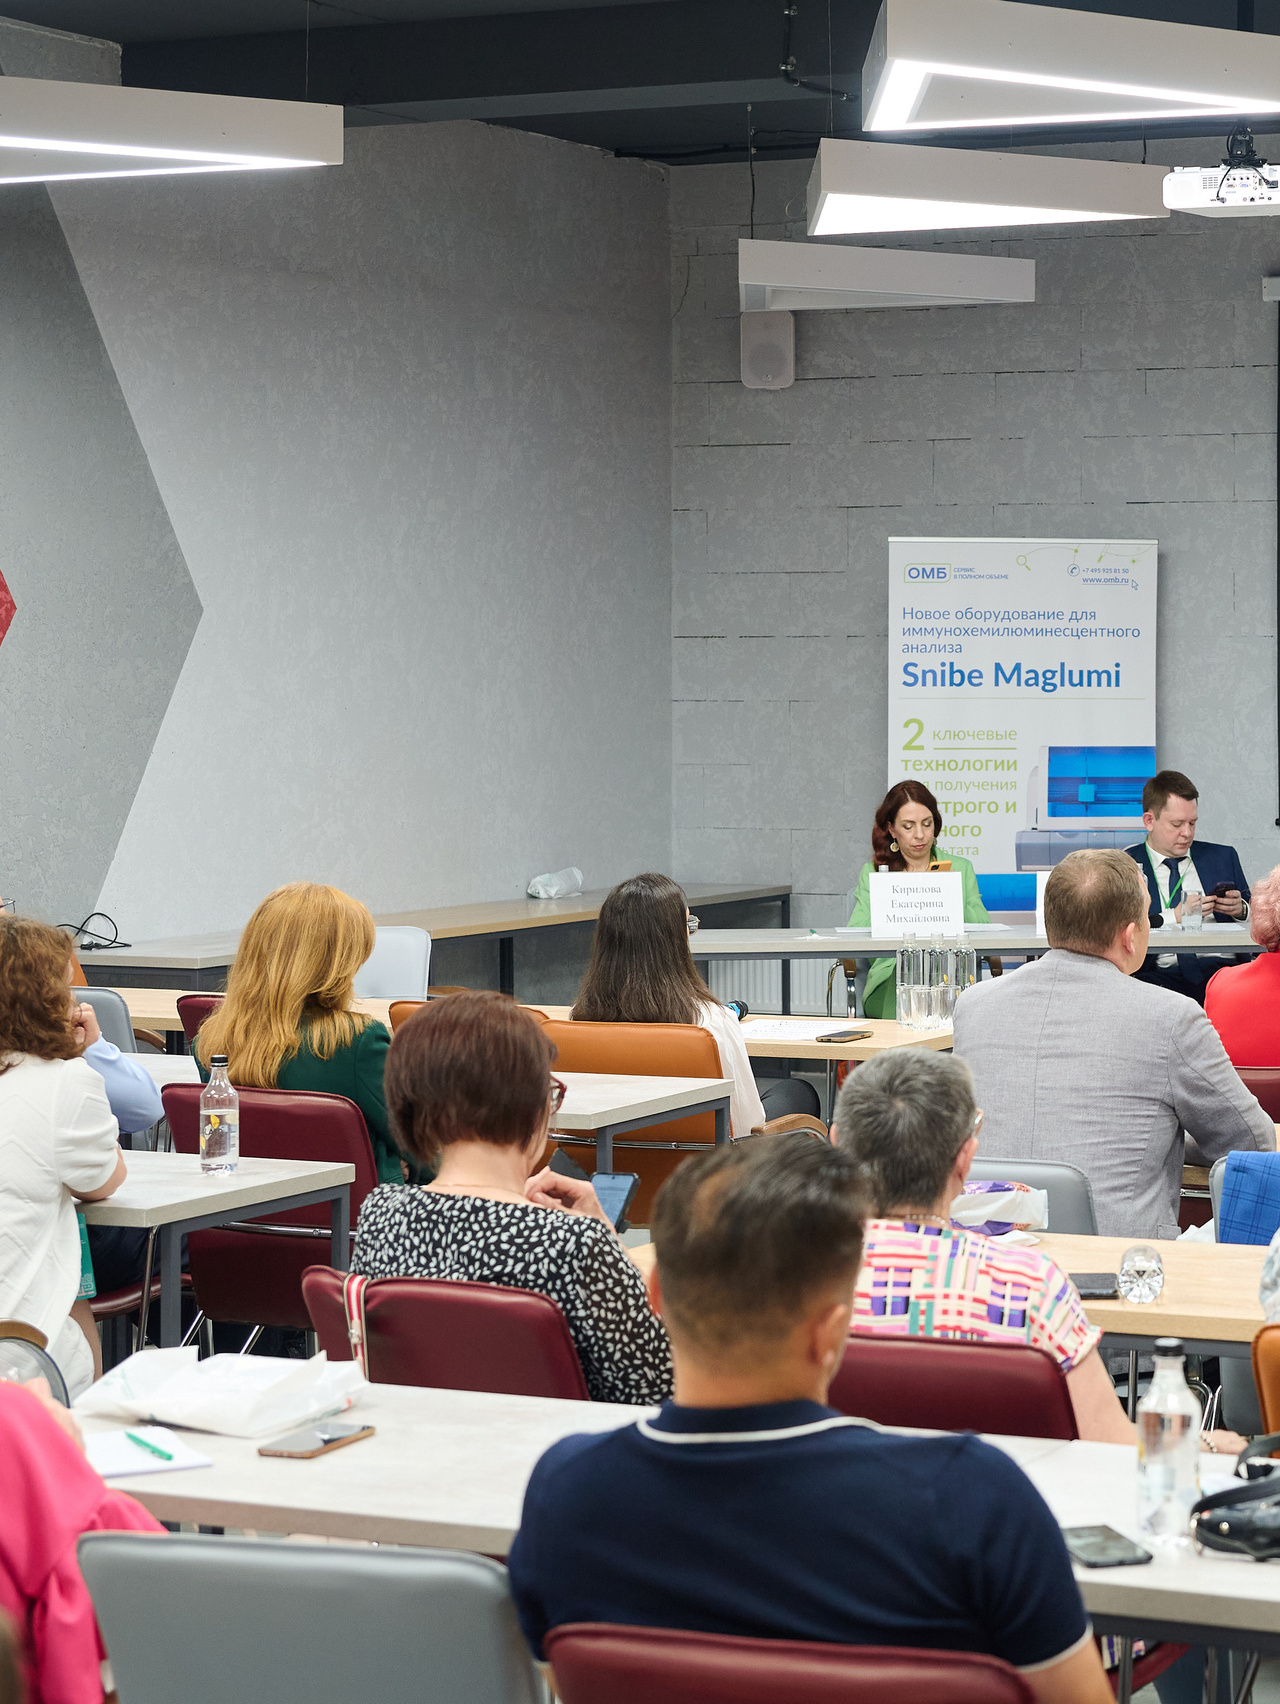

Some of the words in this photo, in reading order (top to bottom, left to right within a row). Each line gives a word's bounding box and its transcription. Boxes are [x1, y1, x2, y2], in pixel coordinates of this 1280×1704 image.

[908, 567, 947, 580] ОМБ
[902, 608, 950, 620] Новое
[955, 608, 1064, 622] оборудование
[1068, 610, 1096, 623] для
[902, 626, 1140, 639] иммунохемилюминесцентного
[902, 642, 962, 654] анализа
[902, 662, 984, 688] Snibe
[994, 662, 1121, 693] Maglumi
[902, 718, 925, 751] 2
[933, 729, 1017, 742] ключевые
[901, 759, 1017, 772] технологии
[935, 780, 1017, 793] получения
[937, 801, 999, 817] трого
[1006, 801, 1017, 813] и
[938, 825, 981, 837] ного
[892, 884, 941, 896] Кирилова
[891, 899, 944, 911] Екатерина
[886, 913, 950, 925] Михайловна
